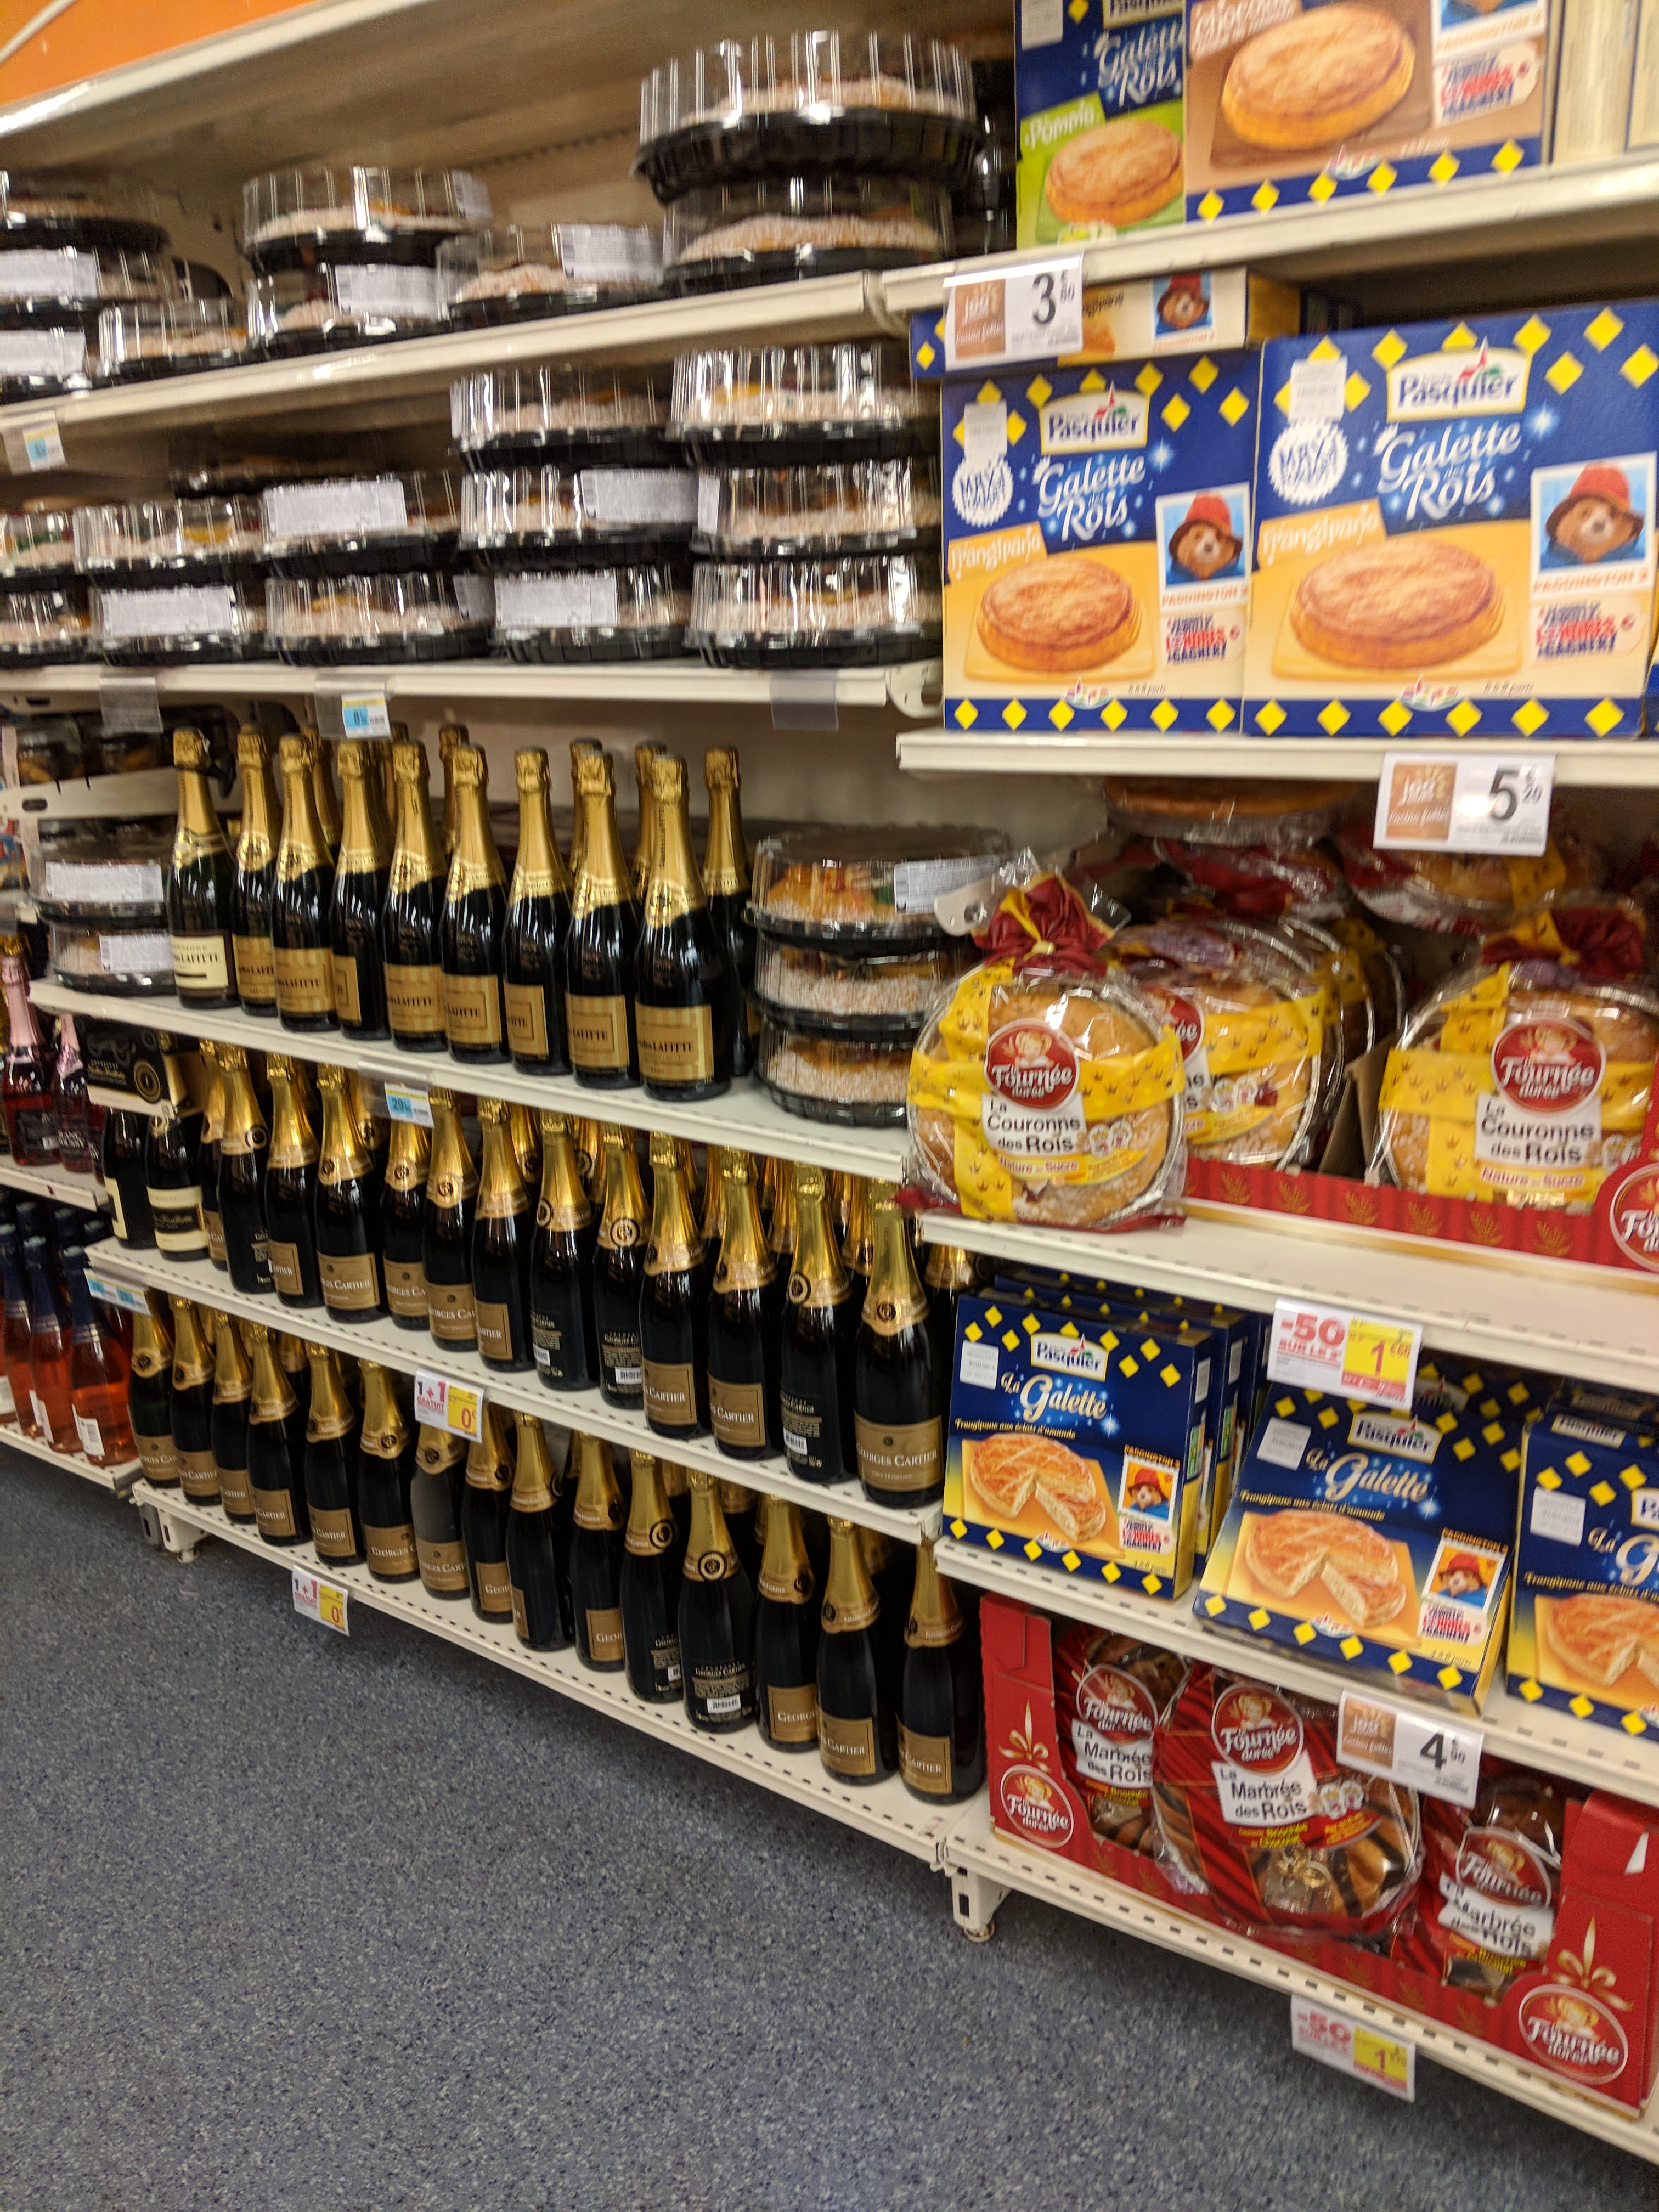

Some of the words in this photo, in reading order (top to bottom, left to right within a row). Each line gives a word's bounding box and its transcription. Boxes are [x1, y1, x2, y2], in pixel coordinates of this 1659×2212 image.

[1033, 273, 1057, 327] 3
[1398, 362, 1519, 410] Pasquier
[1048, 410, 1139, 443] Pasquier
[1374, 421, 1521, 495] Galette
[1032, 454, 1147, 518] Galette
[1402, 461, 1497, 520] Rois
[1056, 488, 1128, 542] Rois
[1491, 765, 1523, 822] 5
[991, 1063, 1074, 1092] Fournée
[989, 1098, 1008, 1114] La
[1485, 1097, 1505, 1118] La
[987, 1114, 1081, 1133] Couronne
[1481, 1114, 1595, 1142] Couronne
[997, 1136, 1023, 1150] des
[1025, 1134, 1074, 1153] Rois
[1490, 1140, 1521, 1159] des
[1525, 1141, 1582, 1165] Rois
[999, 1155, 1033, 1173] Nature
[334, 1279, 371, 1291] CARTIER
[1280, 1312, 1345, 1348] -50
[1037, 1340, 1102, 1373] Pasquier
[1371, 1340, 1386, 1378] 1
[417, 1395, 445, 1412] GRATUIT
[650, 1386, 686, 1403] CARTIER
[1001, 1372, 1020, 1395] La
[1020, 1373, 1107, 1423] Galette
[461, 1408, 472, 1429] 0
[717, 1404, 754, 1423] CARTIER
[955, 1417, 999, 1432] Frangipane
[1037, 1423, 1077, 1441] d'amande
[1356, 1418, 1433, 1453] Pasquier
[856, 1442, 892, 1467] GEORGES
[894, 1449, 937, 1468] CARTIER
[1124, 1443, 1174, 1467] PADDINGTON
[1305, 1448, 1329, 1472] La
[1324, 1452, 1429, 1503] Galette
[317, 1529, 346, 1541] CARTIER
[1442, 1527, 1502, 1552] PADDINGTON
[1587, 1526, 1617, 1554] La
[371, 1547, 409, 1557] GEORGES
[1076, 1724, 1093, 1740] La
[1220, 1722, 1297, 1755] Fournée
[827, 1738, 866, 1756] CARTIER
[1420, 1731, 1447, 1771] 4
[904, 1753, 943, 1774] CARTIER
[1087, 1760, 1108, 1776] des
[1109, 1763, 1151, 1784] Rois
[1219, 1767, 1237, 1781] La
[1231, 1778, 1303, 1801] Marbrée
[1007, 1793, 1069, 1832] Fournée
[1235, 1805, 1260, 1819] des
[1261, 1800, 1308, 1821] Rois
[1528, 2016, 1620, 2066] Fournée
[1374, 2048, 1386, 2072] 1
